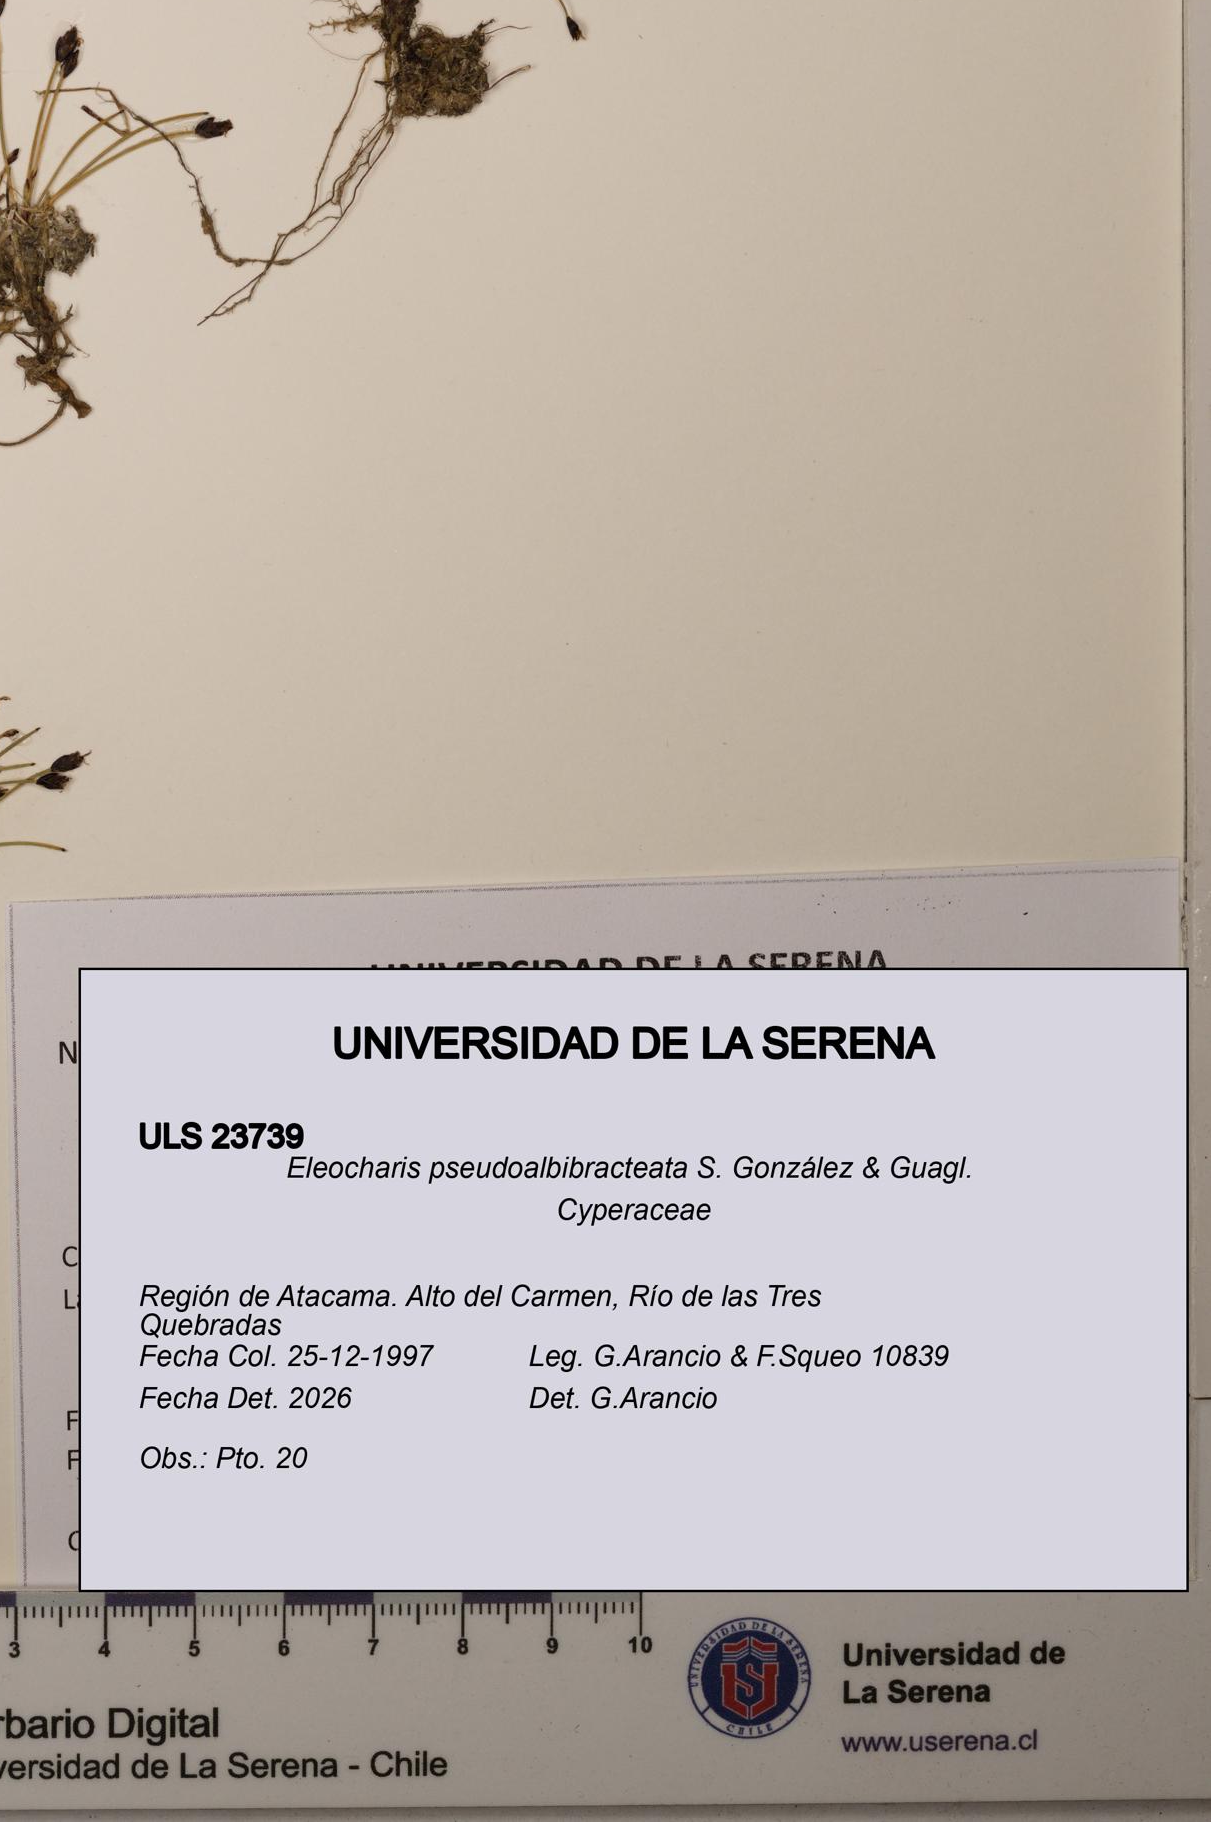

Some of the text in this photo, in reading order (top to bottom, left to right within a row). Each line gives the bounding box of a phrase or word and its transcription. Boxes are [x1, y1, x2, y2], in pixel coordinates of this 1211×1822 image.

[8, 1641, 20, 1659] 3
[98, 1641, 111, 1658] 4
[189, 1640, 200, 1657] 5
[278, 1640, 290, 1656] 6
[368, 1639, 379, 1655] 7
[457, 1639, 469, 1655] 8
[546, 1638, 559, 1654] 9
[629, 1637, 653, 1653] 10
[844, 1640, 1065, 1667] Universidad de
[843, 1679, 990, 1704] La Serena
[108, 1707, 219, 1745] Digital
[840, 1729, 1037, 1753] www.userena.cl
[131, 1753, 168, 1779] de
[180, 1752, 216, 1779] La
[228, 1752, 338, 1779] Serena
[370, 1750, 447, 1777] Chile
